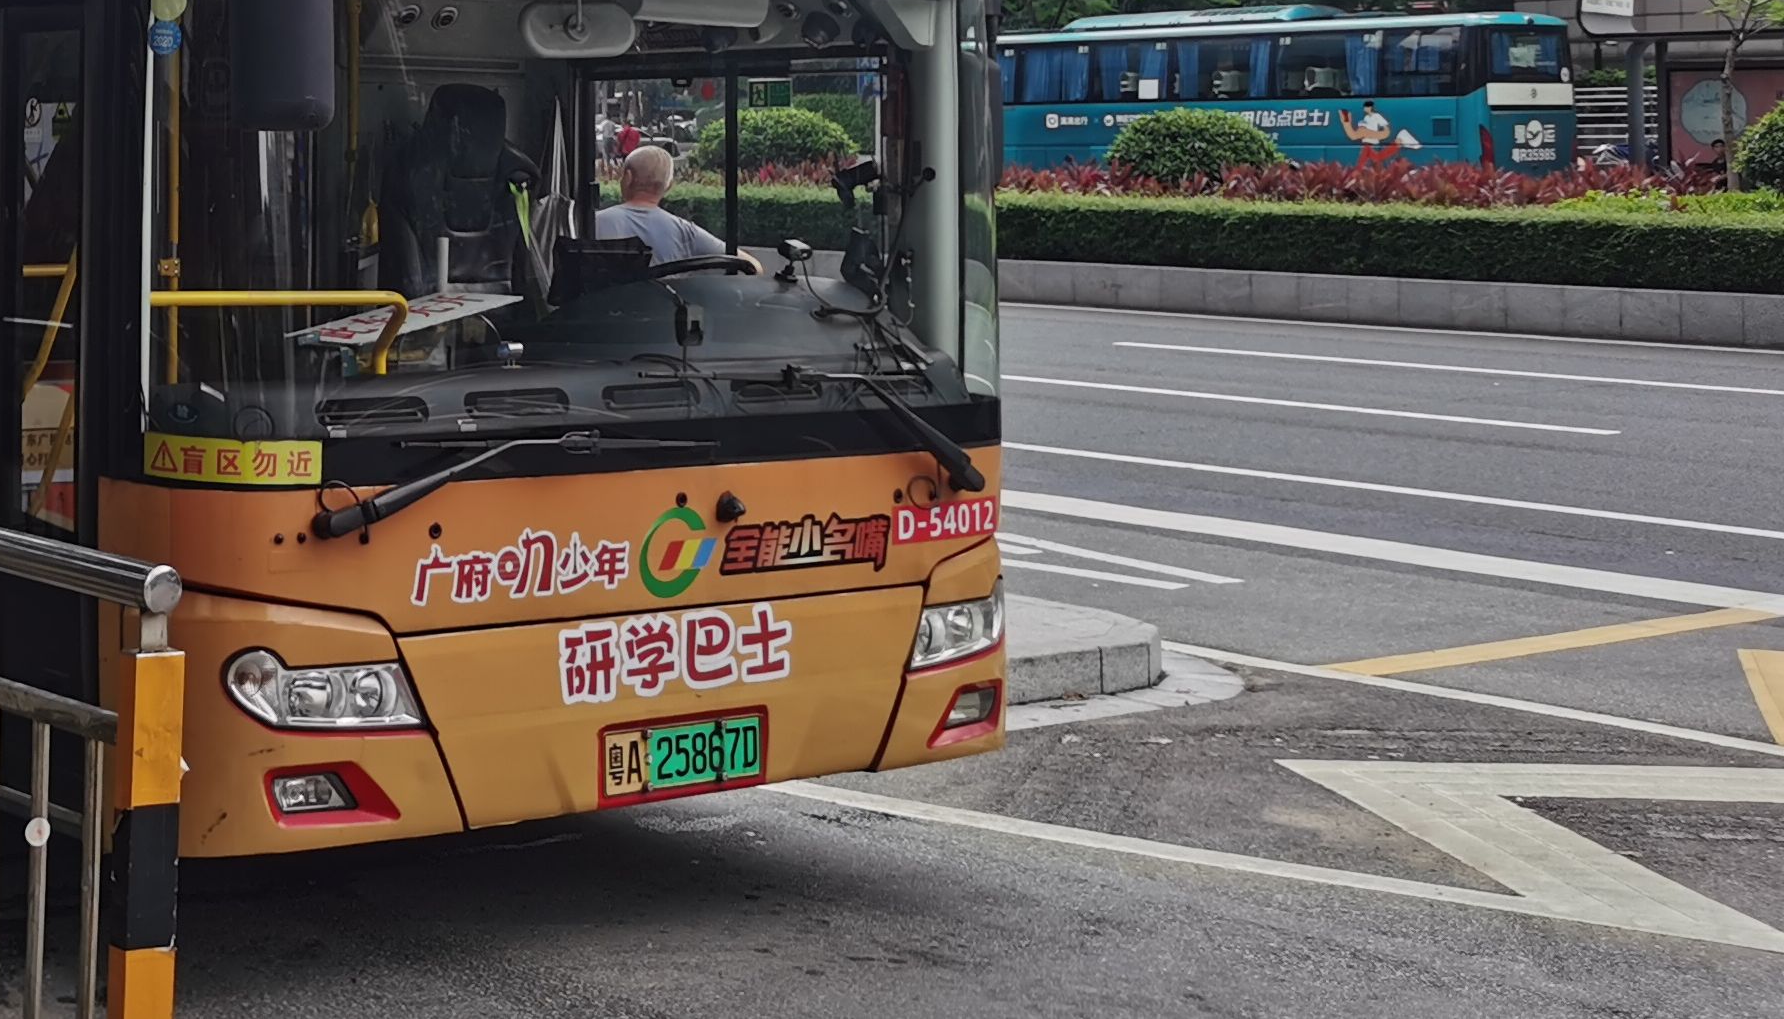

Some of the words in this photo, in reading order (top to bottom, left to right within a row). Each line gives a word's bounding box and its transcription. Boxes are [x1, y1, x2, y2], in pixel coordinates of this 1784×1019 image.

[181, 445, 313, 477] 盲区勿近
[721, 513, 890, 572] 全能小名嘴
[897, 500, 995, 541] D-54012
[412, 529, 628, 605] 广府叻少年
[562, 606, 790, 702] 研学巴士
